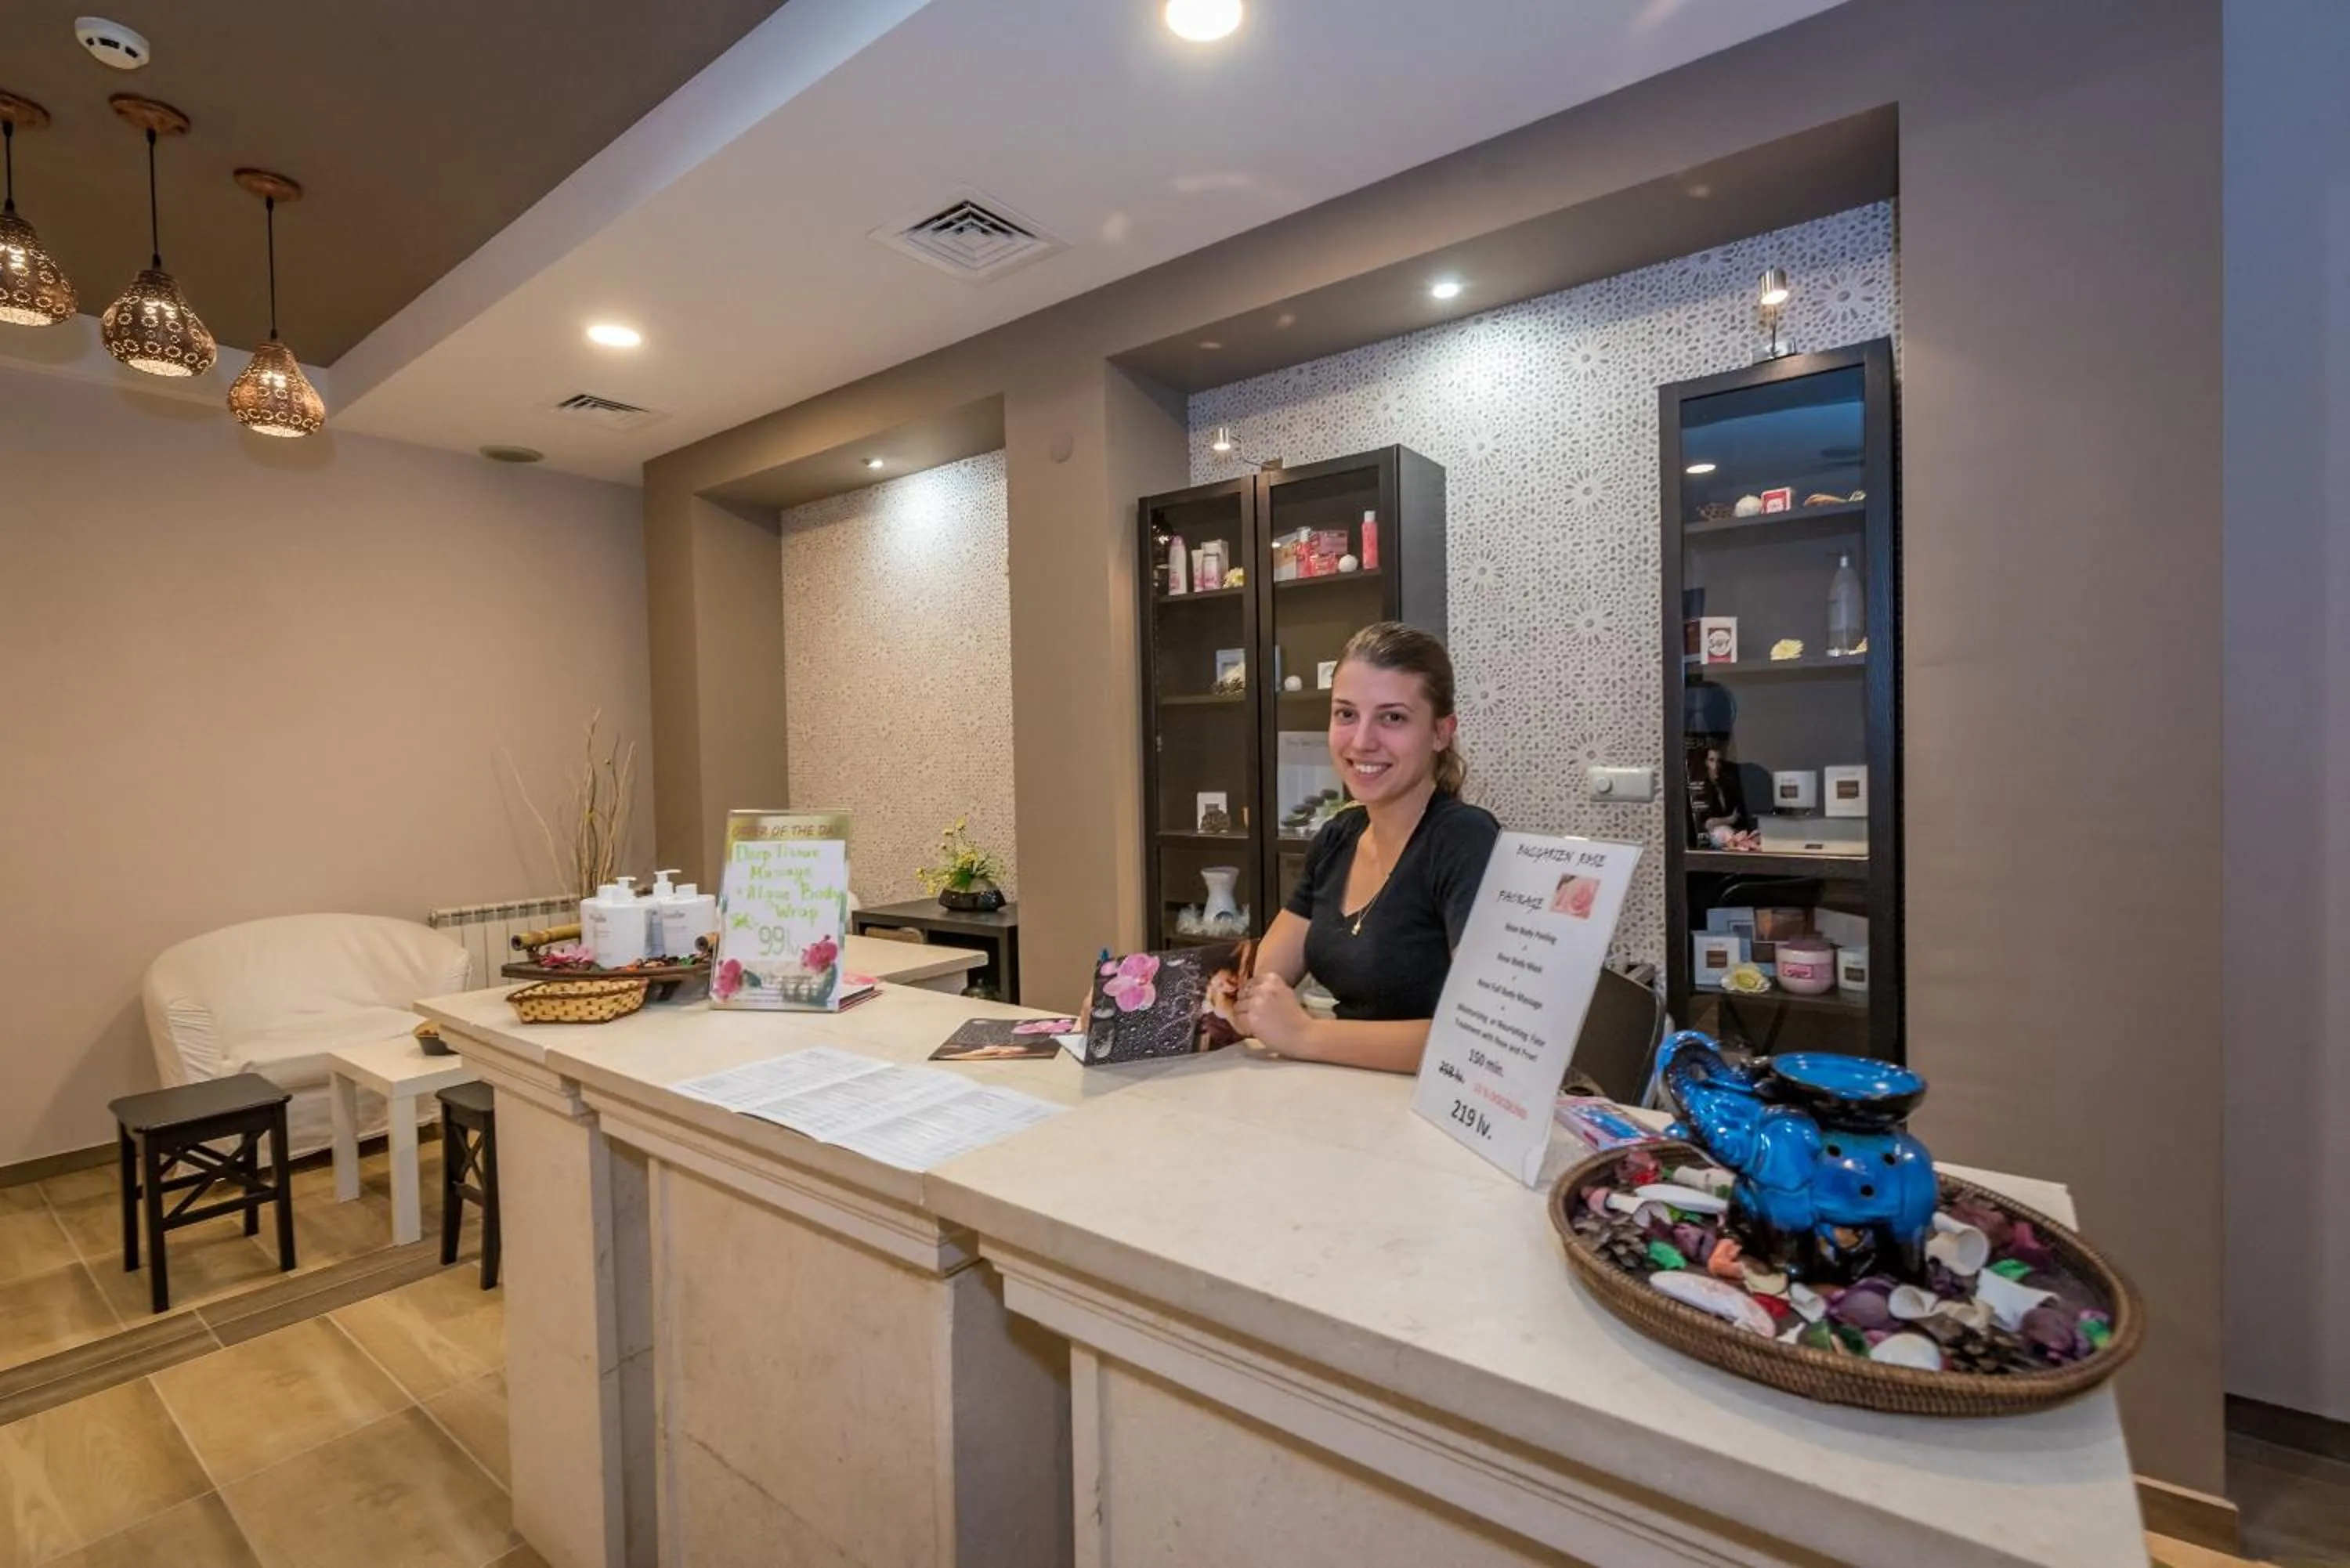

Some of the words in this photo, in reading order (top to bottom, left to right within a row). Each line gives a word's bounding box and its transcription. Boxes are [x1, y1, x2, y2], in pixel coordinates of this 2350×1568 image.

[771, 826, 787, 837] OF
[791, 825, 814, 836] THE
[736, 844, 772, 866] Deep
[776, 903, 818, 926] Wrap
[758, 925, 784, 956] 99
[1469, 1048, 1485, 1067] 150
[1451, 1099, 1477, 1128] 219
[1476, 1113, 1492, 1140] lv.
